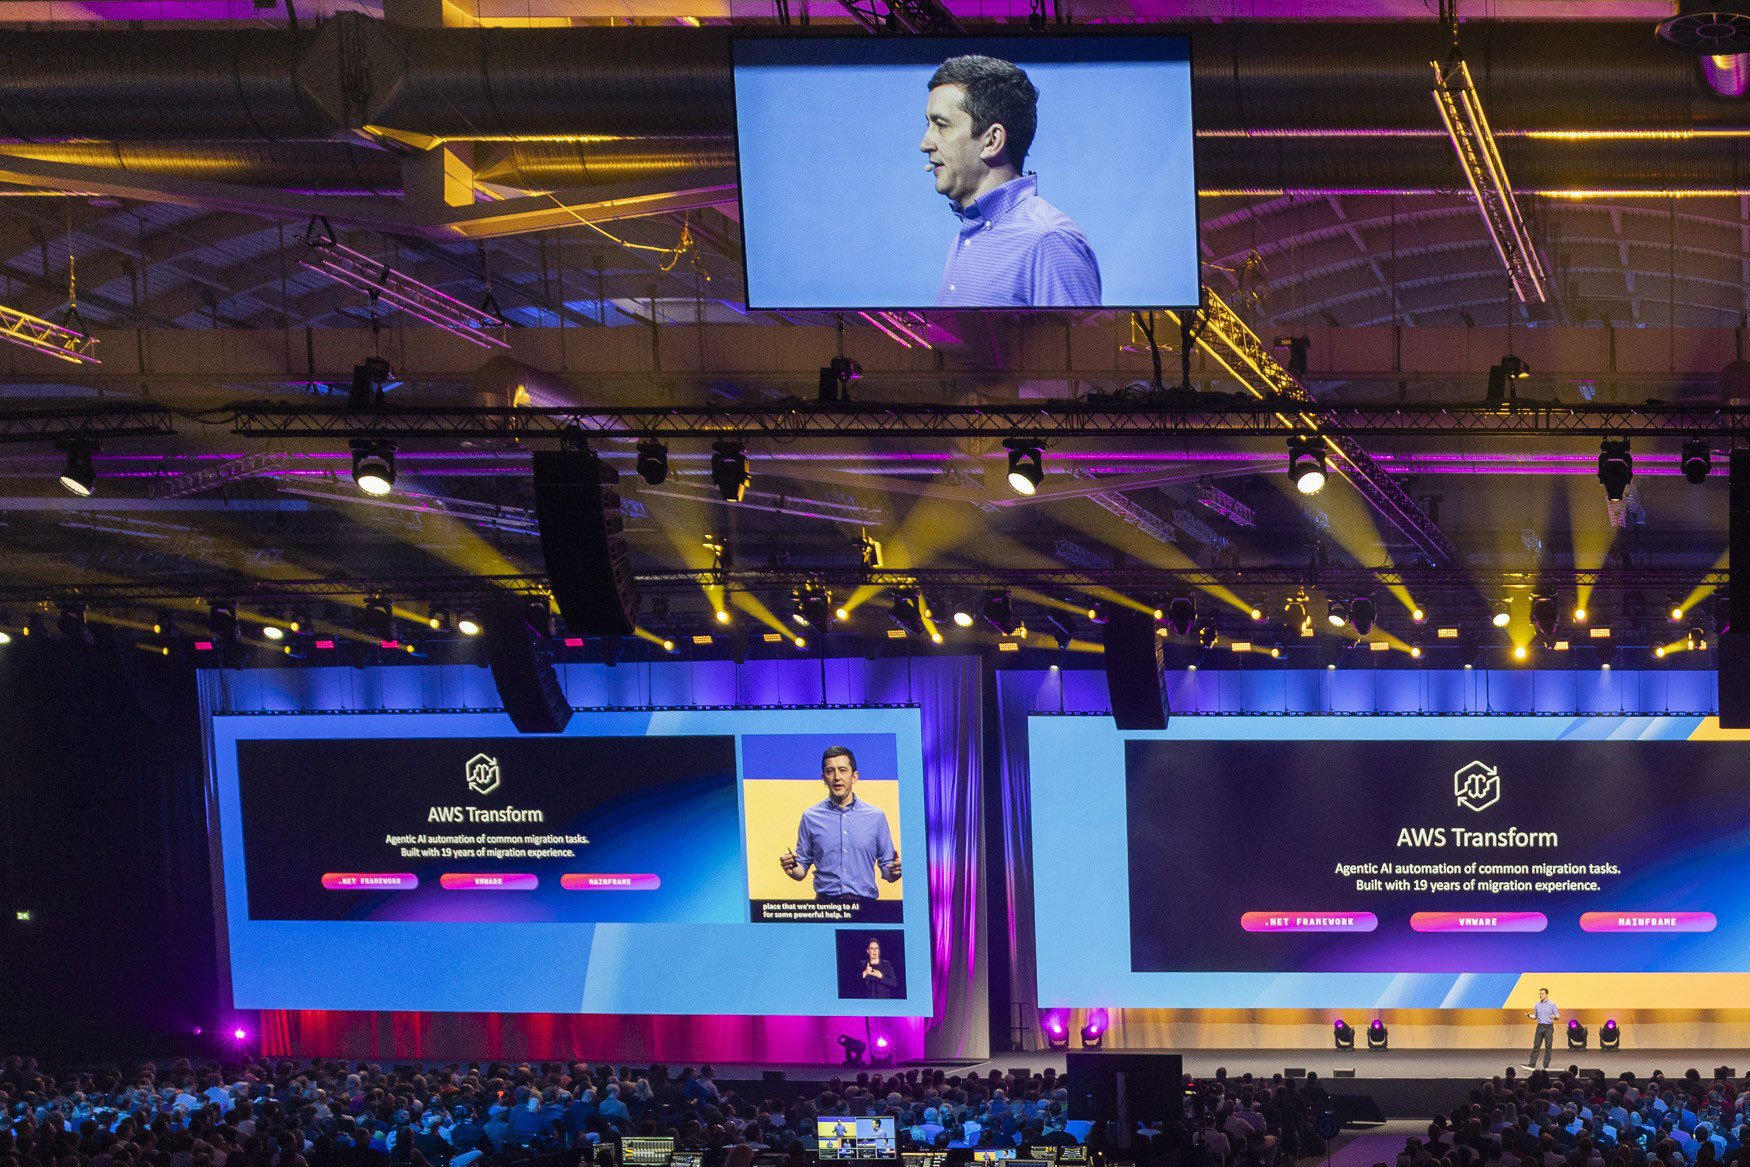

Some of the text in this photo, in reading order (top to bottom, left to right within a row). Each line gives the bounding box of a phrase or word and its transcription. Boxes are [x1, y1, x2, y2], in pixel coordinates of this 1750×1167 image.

[428, 805, 543, 823] AWS Transform
[385, 833, 589, 846] Agentic AI automation of common migration tasks.
[1397, 826, 1558, 847] AWS Transform
[401, 847, 575, 859] Built with 19 years of migration experience.
[1335, 862, 1621, 876] Agentic AI automation of common migration tasks.
[360, 877, 402, 885] FRAMEWORK
[1356, 879, 1601, 893] Built with 19 years of migration experience.
[763, 903, 781, 911] place
[816, 903, 842, 911] turning
[763, 910, 774, 918] for
[793, 911, 824, 919] powerful
[825, 910, 843, 919] help.
[1265, 917, 1354, 926] .NET FRAMEWORK
[1459, 918, 1497, 926] VMWARE
[1618, 917, 1676, 926] MAINFRAME
